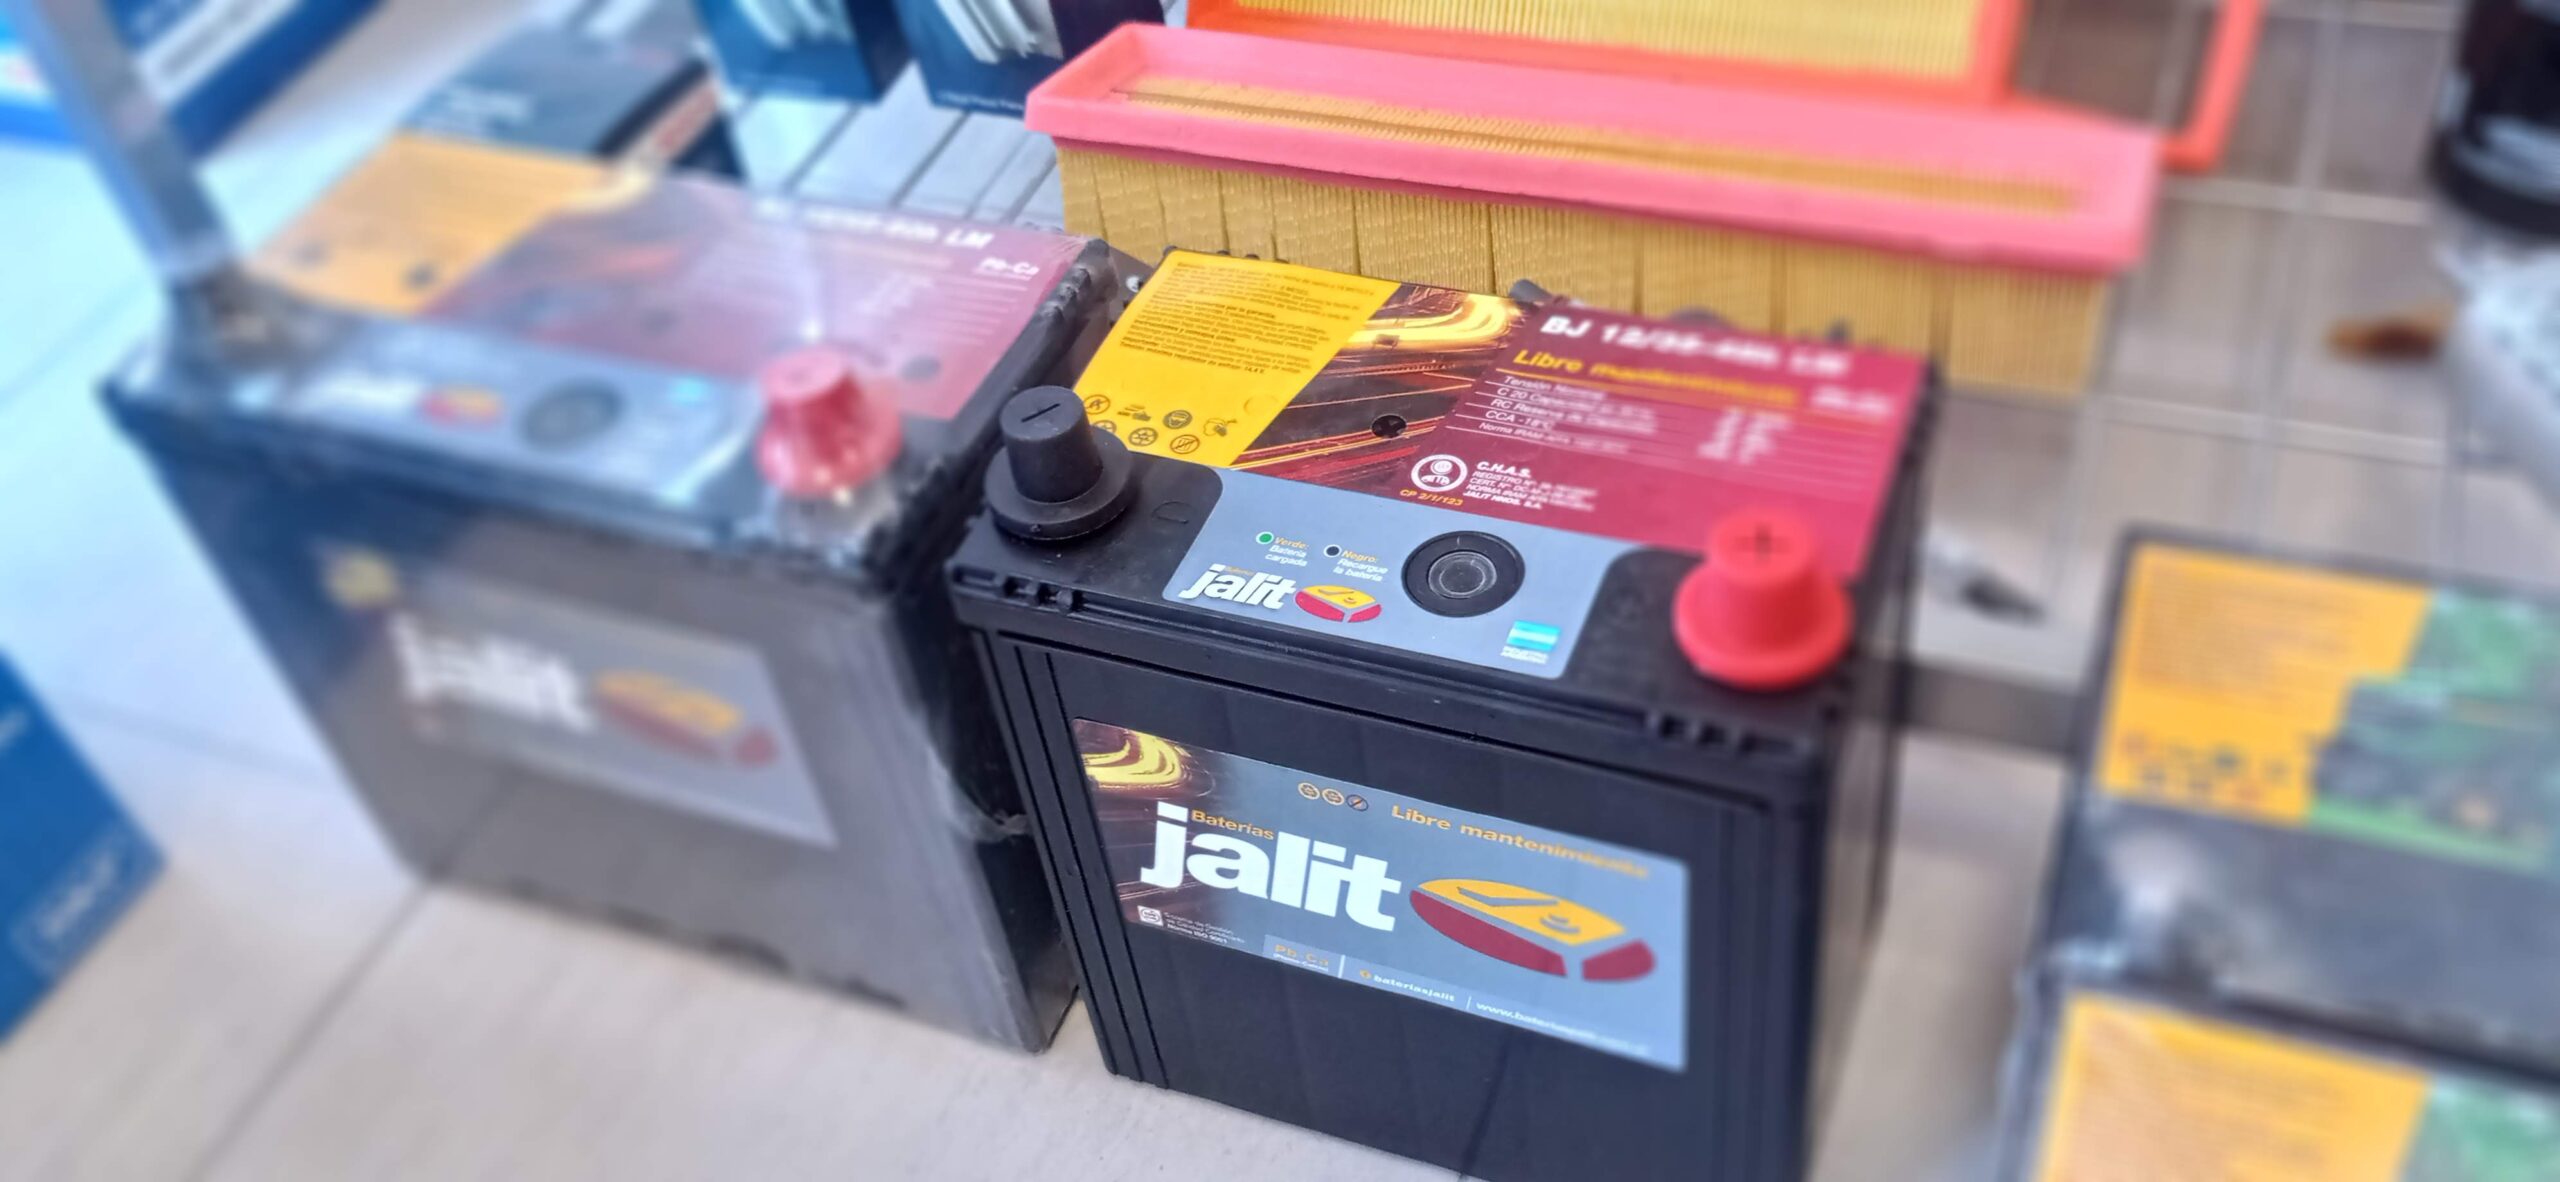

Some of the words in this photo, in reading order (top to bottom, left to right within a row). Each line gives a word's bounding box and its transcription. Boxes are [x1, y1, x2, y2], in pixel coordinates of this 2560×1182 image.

[1539, 314, 1594, 338] BJ
[1512, 348, 1585, 373] Libre
[1504, 375, 1552, 390] Tensión
[1497, 387, 1509, 396] C
[1510, 390, 1528, 399] 20
[1490, 398, 1513, 409] RC
[1485, 410, 1516, 423] CCA
[1479, 422, 1513, 434] Norma
[1472, 471, 1523, 486] REGISTRO
[1399, 488, 1418, 498] CP
[1419, 492, 1464, 507] 2/1/123
[1274, 536, 1309, 551] Verde:
[1269, 545, 1307, 559] Batería
[1341, 549, 1377, 564] Negro:
[1264, 553, 1308, 567] cargada
[1337, 557, 1388, 575] Recargue
[1333, 565, 1344, 575] la
[1178, 563, 1296, 610] jalit
[1191, 808, 1275, 841] Baterías
[1391, 804, 1452, 831] Libre
[1139, 801, 1401, 932] jalit
